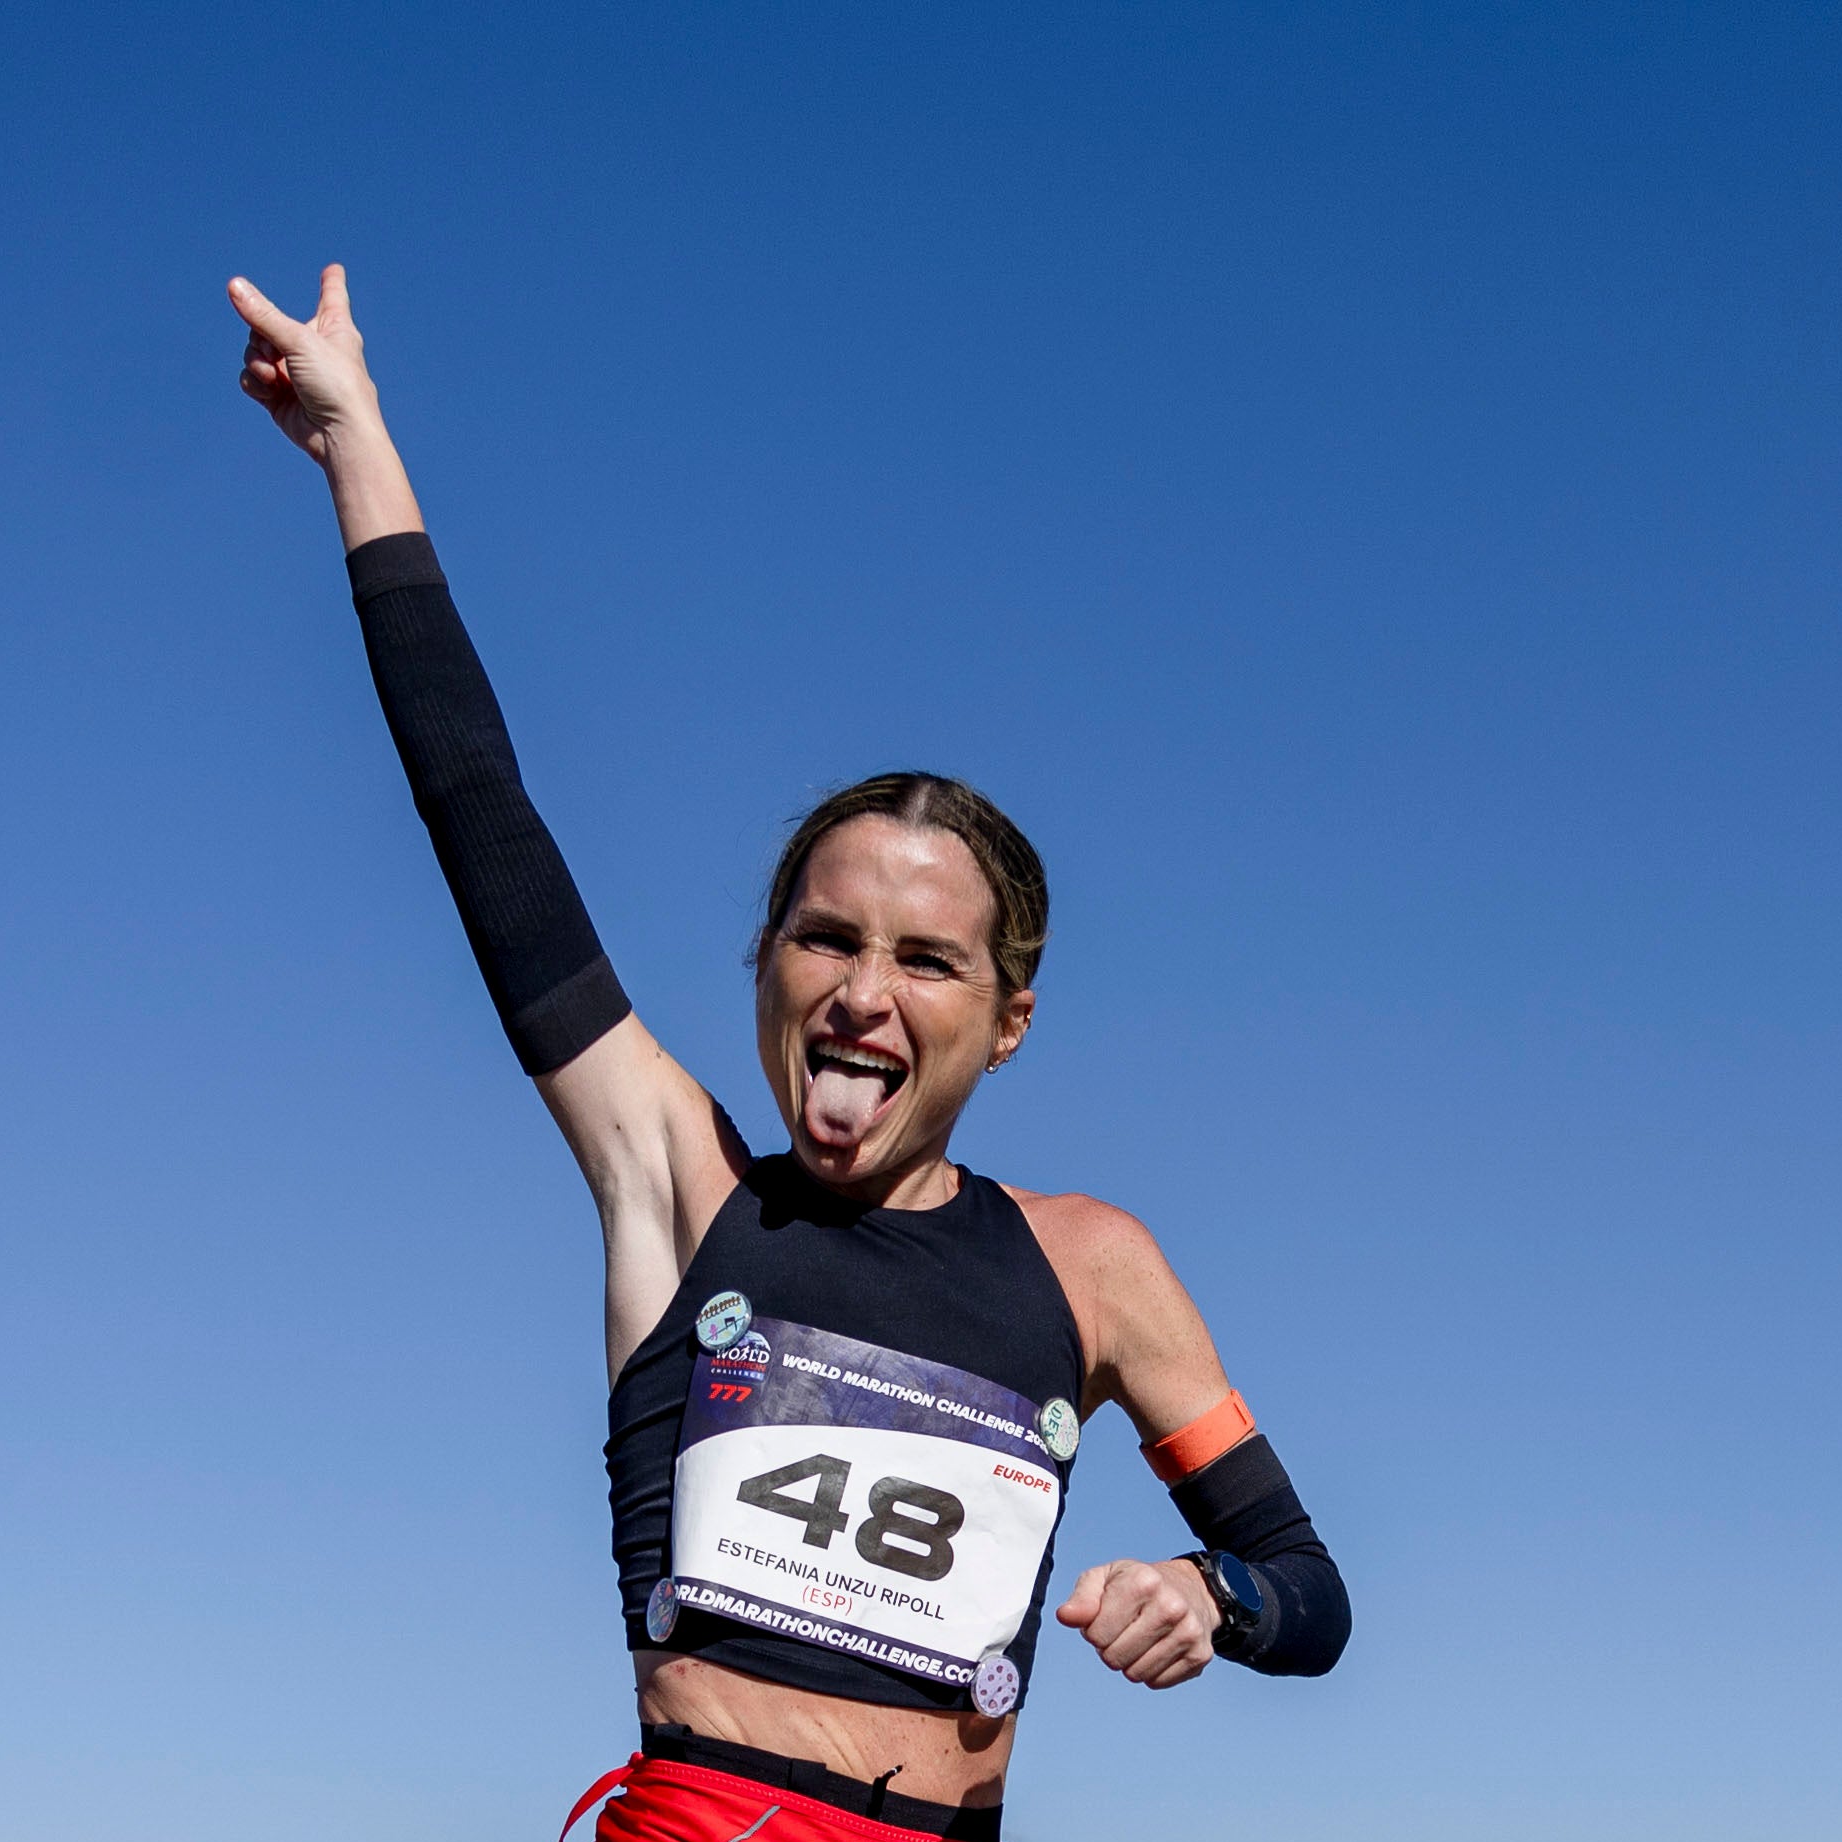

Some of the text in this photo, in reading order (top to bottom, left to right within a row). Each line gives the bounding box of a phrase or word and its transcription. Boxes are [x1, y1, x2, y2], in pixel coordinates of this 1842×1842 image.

[708, 1383, 753, 1402] 777
[781, 1353, 842, 1381] WORLD
[841, 1370, 936, 1409] MARATHON
[936, 1399, 1025, 1439] CHALLENGE
[992, 1464, 1052, 1494] EUROPE
[736, 1453, 965, 1581] 48
[717, 1537, 945, 1621] ESTEFANIA UNZU RIPOLL
[802, 1585, 853, 1616] (ESP)
